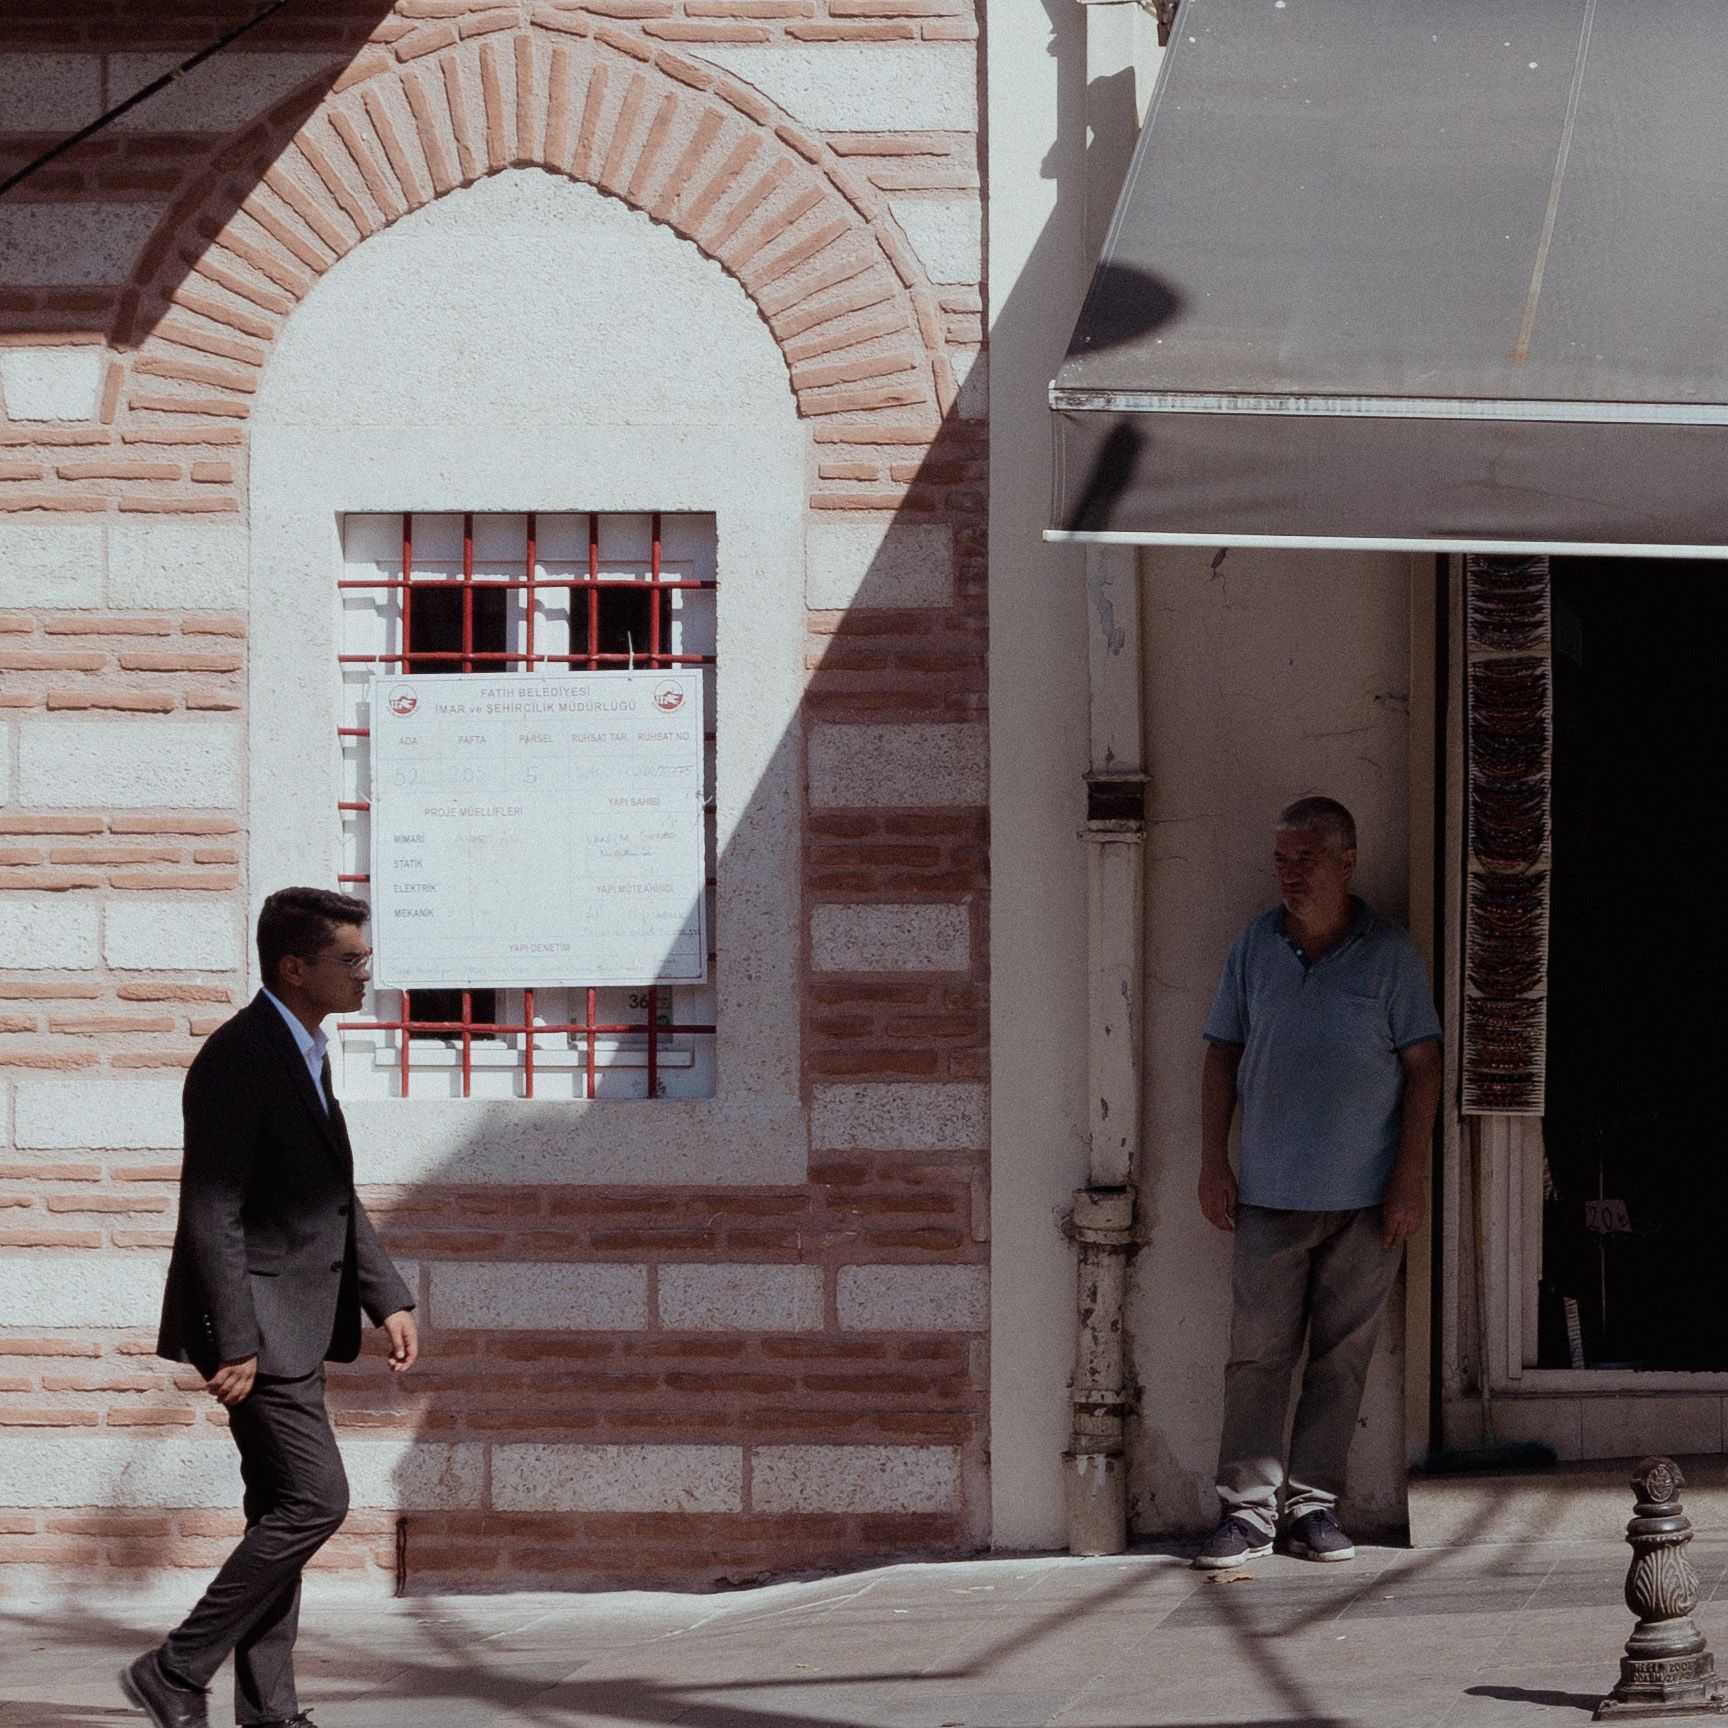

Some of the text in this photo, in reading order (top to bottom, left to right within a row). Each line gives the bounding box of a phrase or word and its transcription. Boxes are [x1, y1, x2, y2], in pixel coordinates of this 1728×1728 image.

[480, 685, 590, 699] FATİH BELEDİYESİ
[434, 702, 465, 714] İMAR
[486, 701, 554, 715] ŞEHİRCİLİK
[558, 699, 636, 713] MÜDÜRLÜĞÜ
[398, 736, 418, 746] ADA
[457, 735, 487, 745] PAFTA
[518, 734, 554, 744] PARSEL
[571, 733, 607, 743] RUHSAT
[637, 731, 674, 742] RUHSAT
[424, 807, 456, 818] PROJE
[393, 832, 425, 844] MİMARİ
[393, 858, 423, 869] STATİK
[393, 883, 437, 893] ELEKTRİK
[394, 907, 434, 918] MEKANİK
